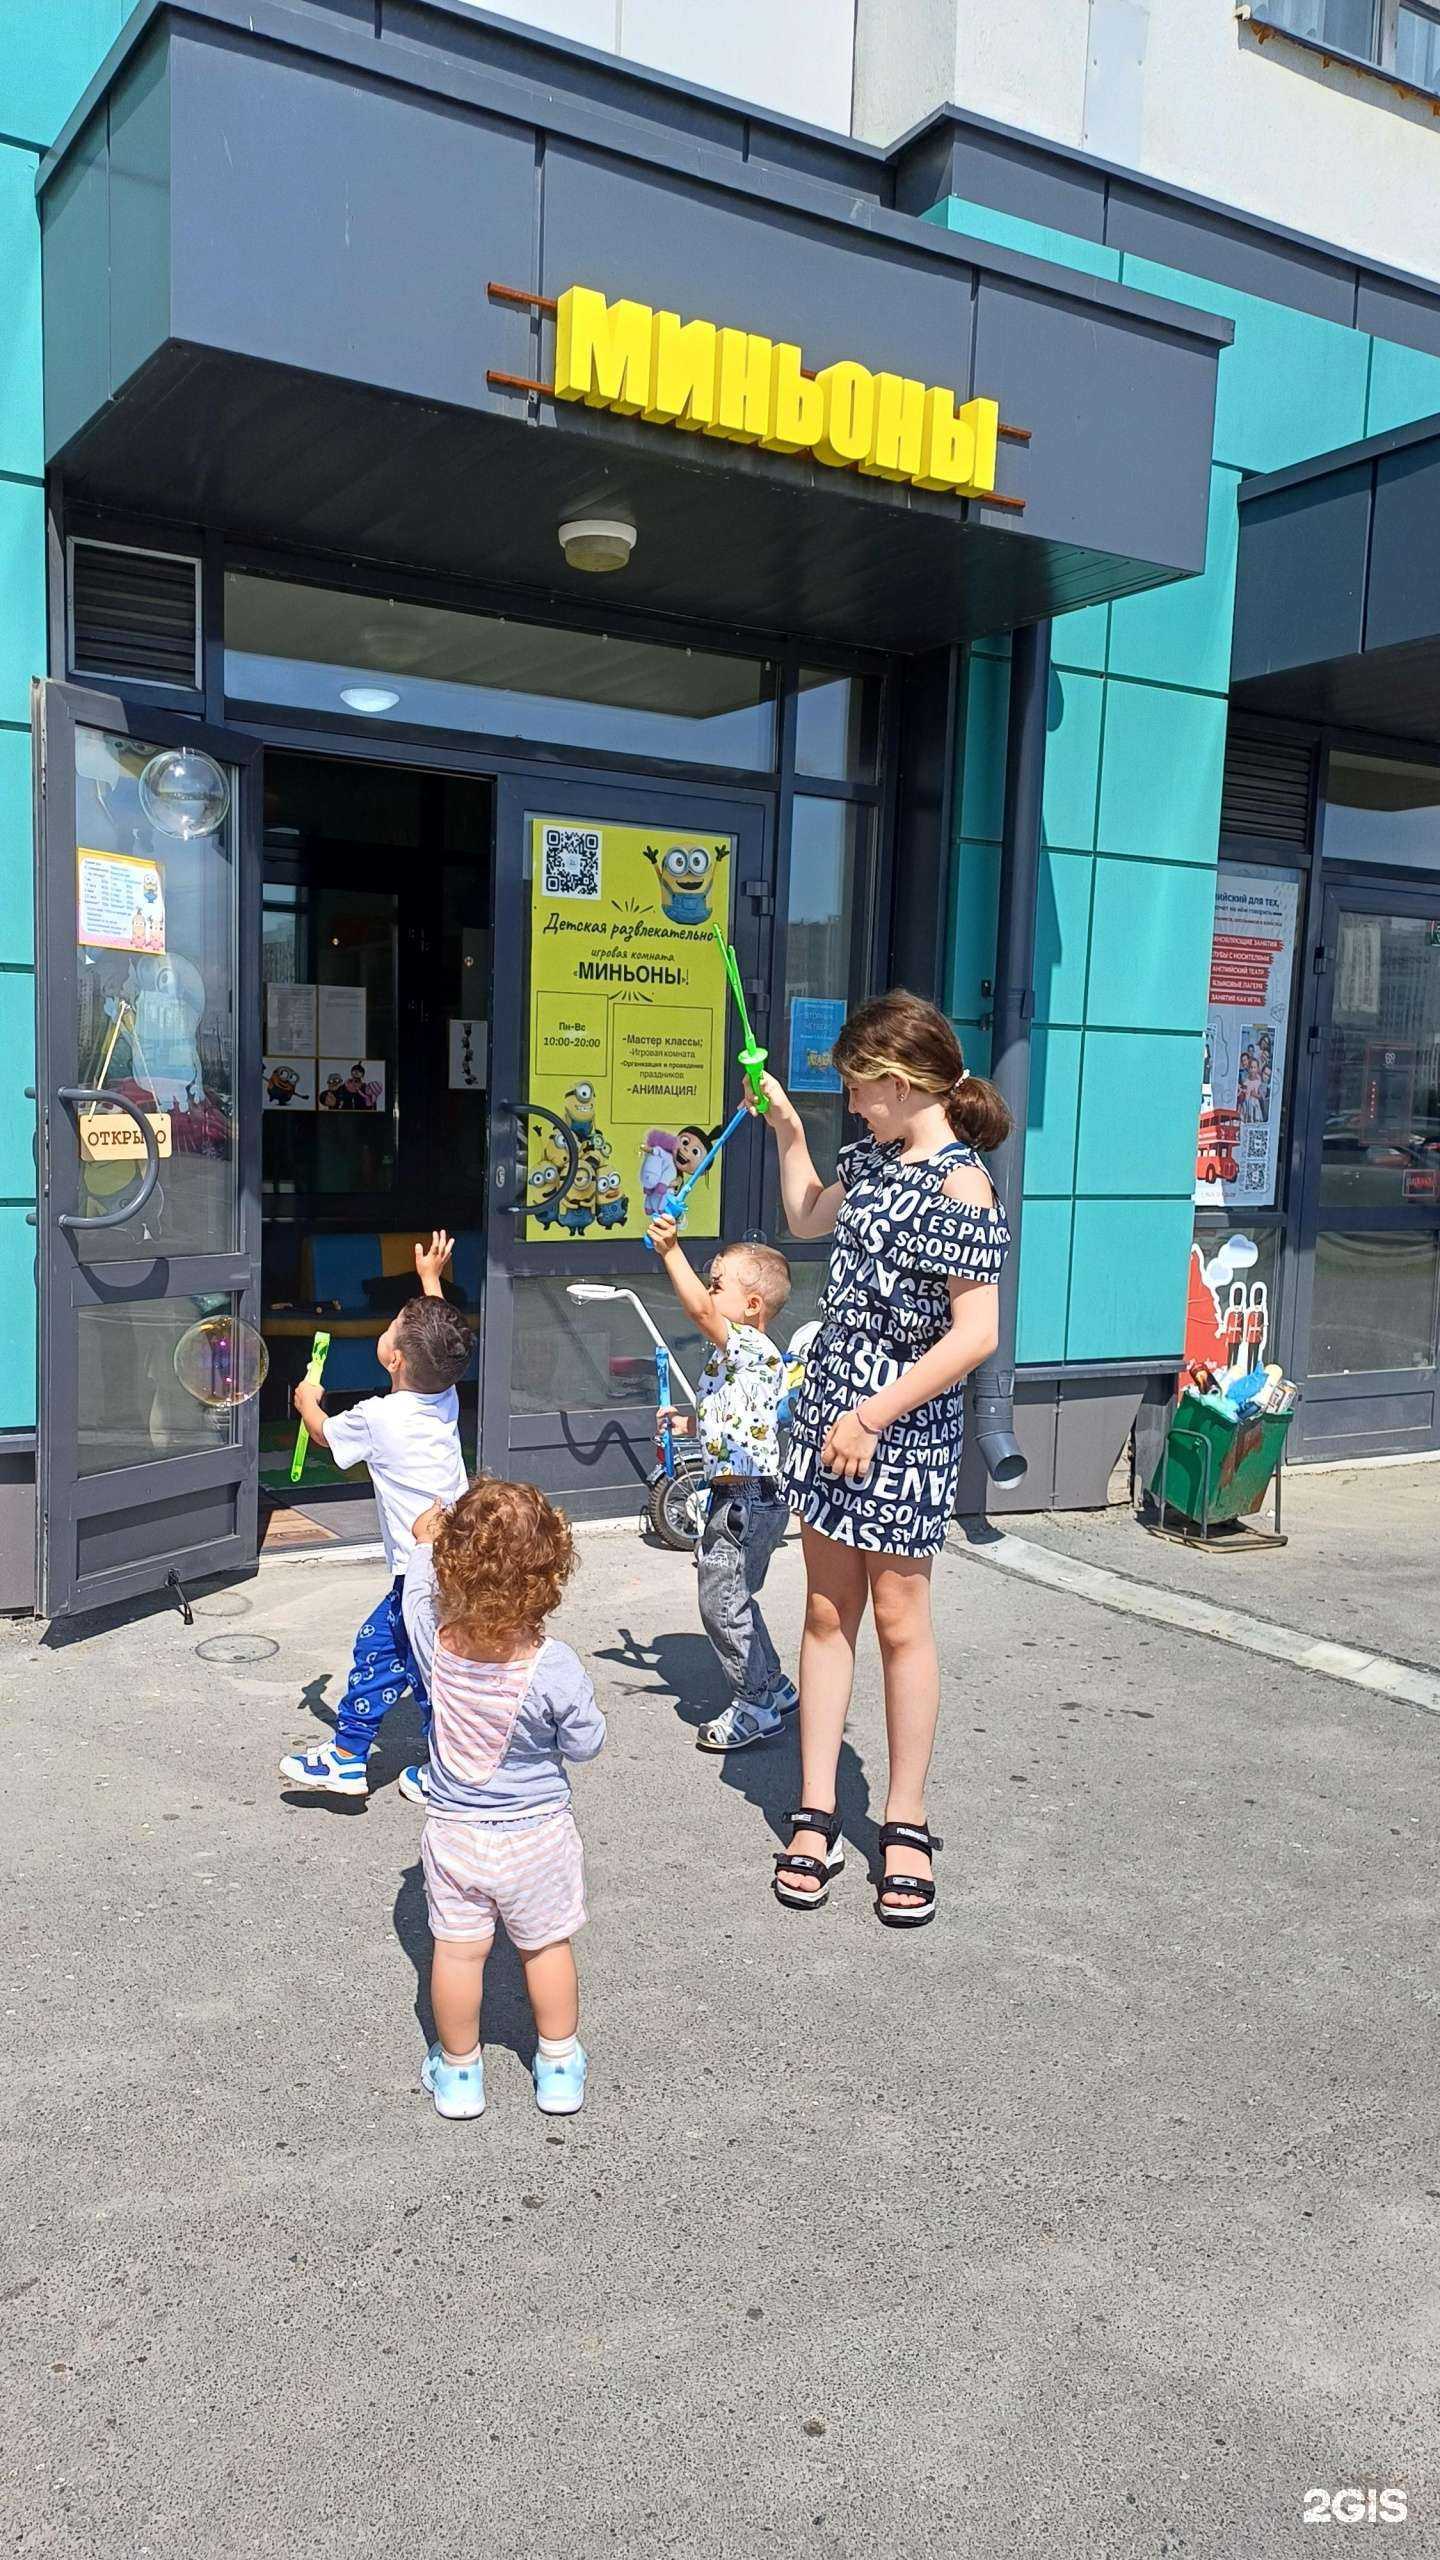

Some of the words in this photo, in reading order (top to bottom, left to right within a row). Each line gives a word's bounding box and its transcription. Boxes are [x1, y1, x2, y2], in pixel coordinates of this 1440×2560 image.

[555, 285, 998, 498] МИНЬОНЫ
[1248, 896, 1264, 905] ДЛЯ
[543, 913, 607, 934] Детская
[591, 946, 628, 960] игровая
[630, 951, 675, 962] комната
[559, 1022, 586, 1032] Пн-Вс
[543, 1037, 600, 1048] 10:00-20:00
[627, 1084, 698, 1097] -АНИМАЦИЯ!
[88, 1130, 166, 1146] ОТКРЫО
